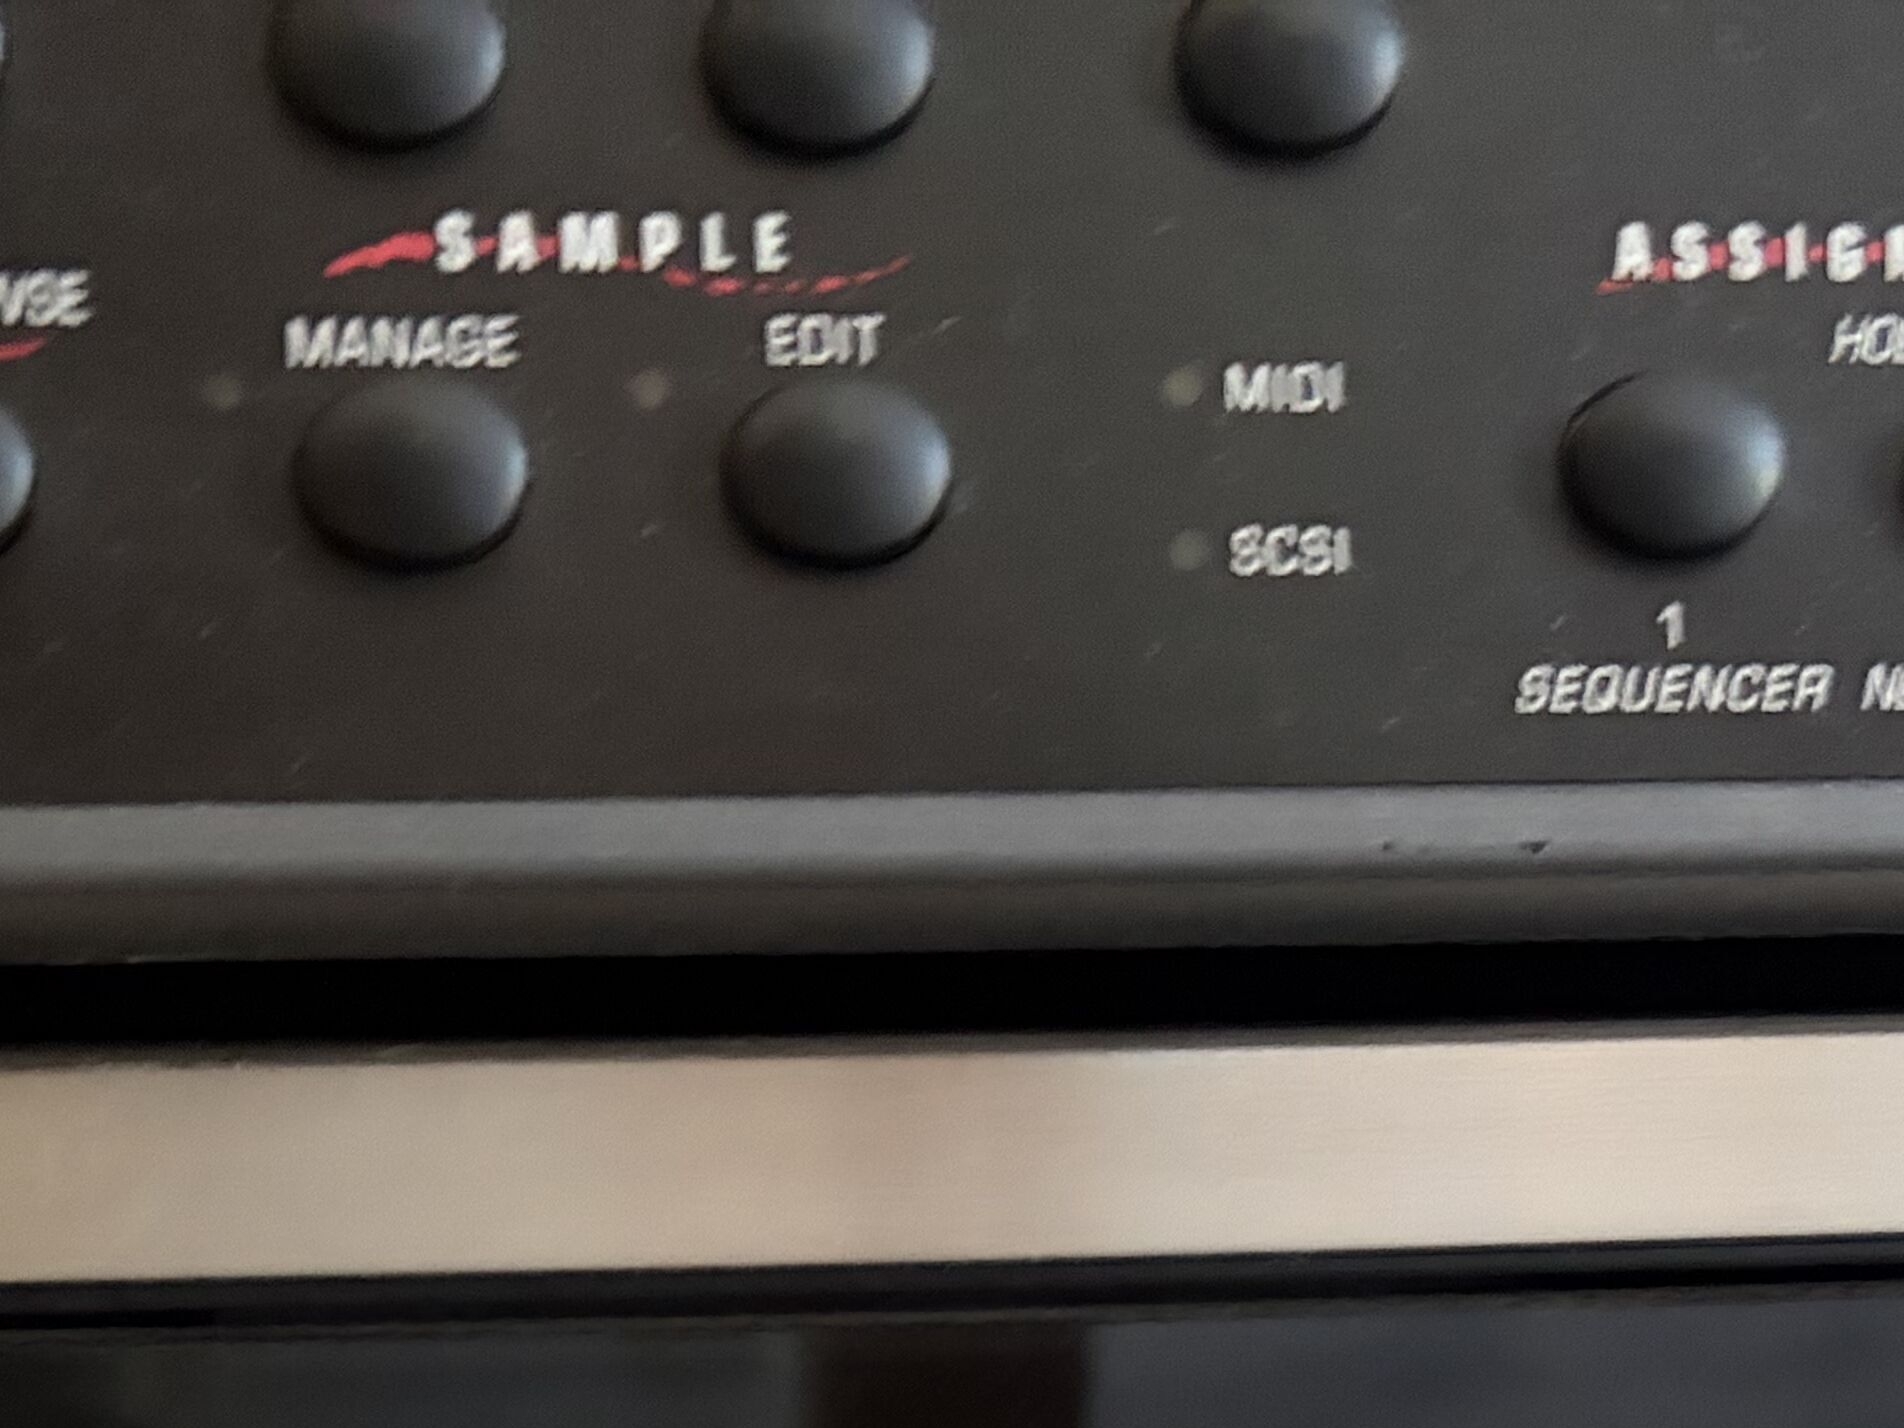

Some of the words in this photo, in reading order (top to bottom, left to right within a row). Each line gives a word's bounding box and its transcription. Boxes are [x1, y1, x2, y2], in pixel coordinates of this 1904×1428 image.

[434, 210, 793, 276] SAMPLE
[284, 316, 520, 372] MANAGE
[764, 315, 887, 368] EDIT
[1223, 362, 1346, 414] MIDI
[1227, 525, 1351, 576] SCSI
[1654, 601, 1686, 649] 1
[1512, 664, 1836, 716] SEQUENCER
